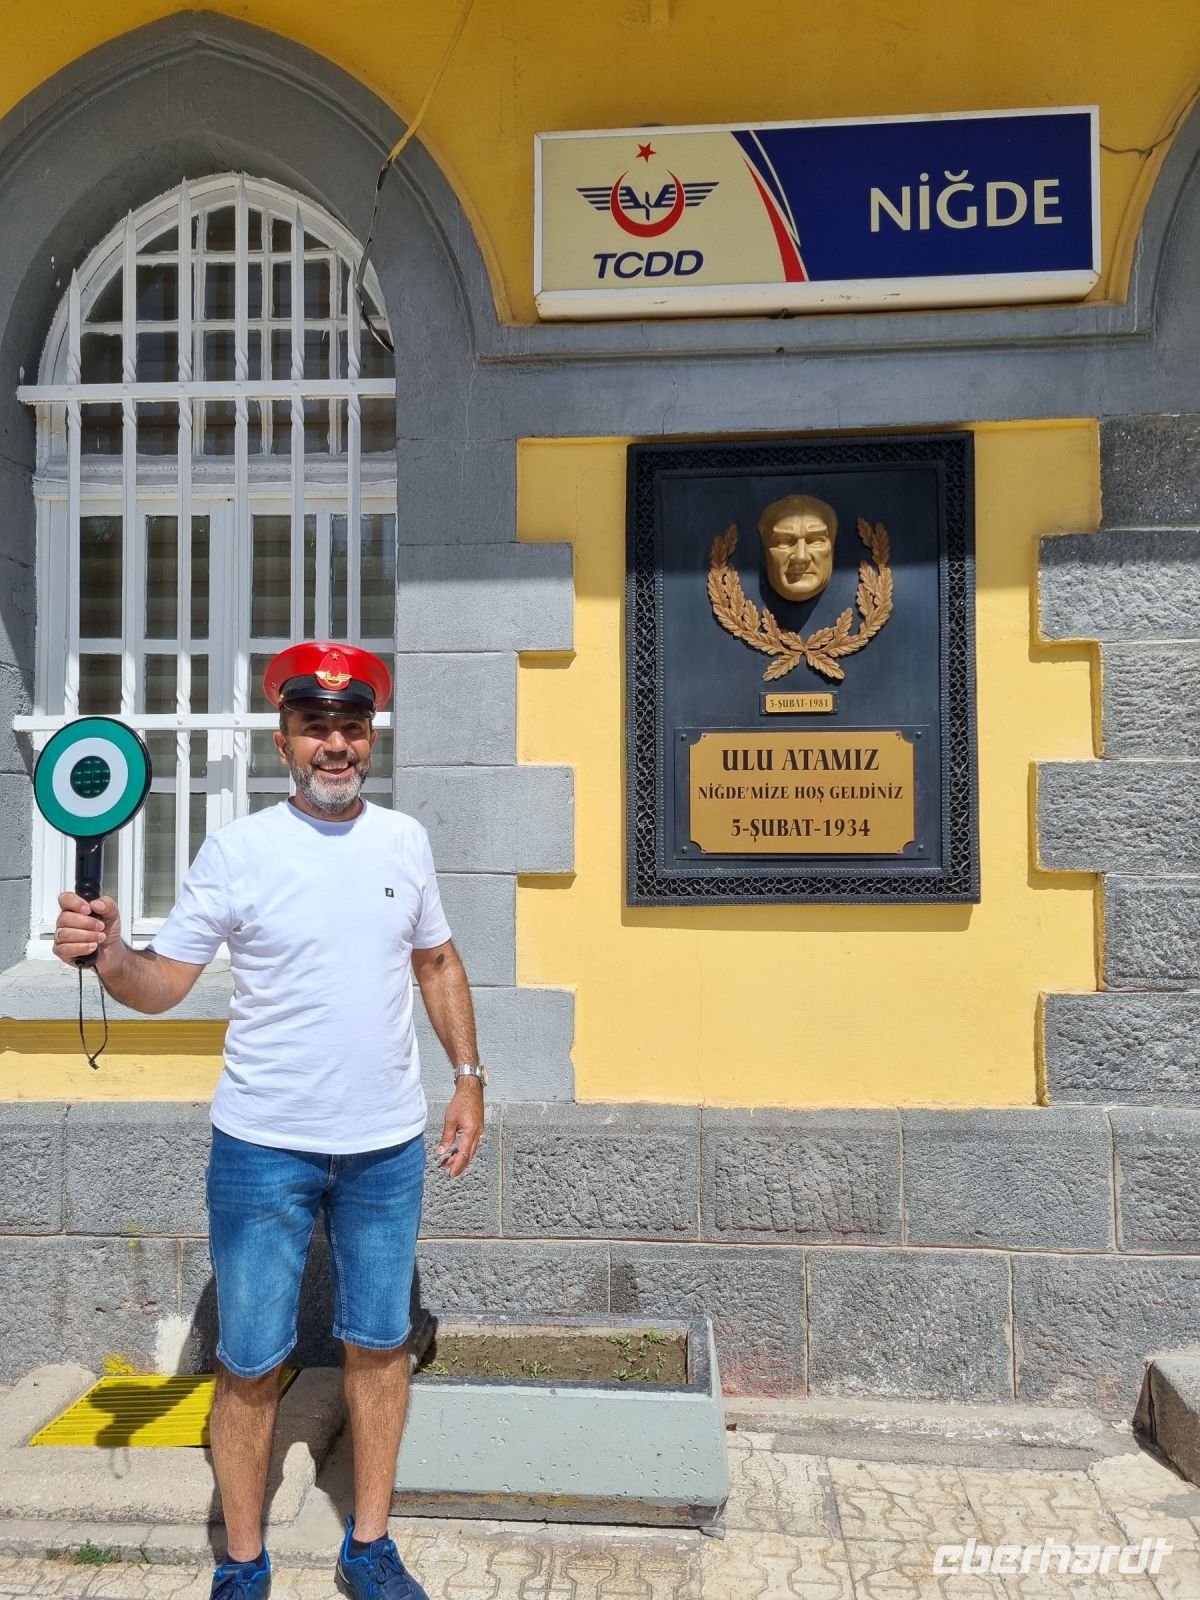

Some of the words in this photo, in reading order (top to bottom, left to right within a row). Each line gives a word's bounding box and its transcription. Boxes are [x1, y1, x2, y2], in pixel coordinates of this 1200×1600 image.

[870, 169, 1063, 233] NİĞDE
[593, 249, 704, 279] TCDD
[722, 749, 773, 771] ULU
[782, 748, 880, 771] ATAMIZ
[698, 782, 789, 800] NİĞDE'MİZE
[794, 786, 825, 803] HOŞ
[829, 782, 903, 800] GELDİNİZ
[730, 818, 871, 843] 5-ŞUBAT-1934
